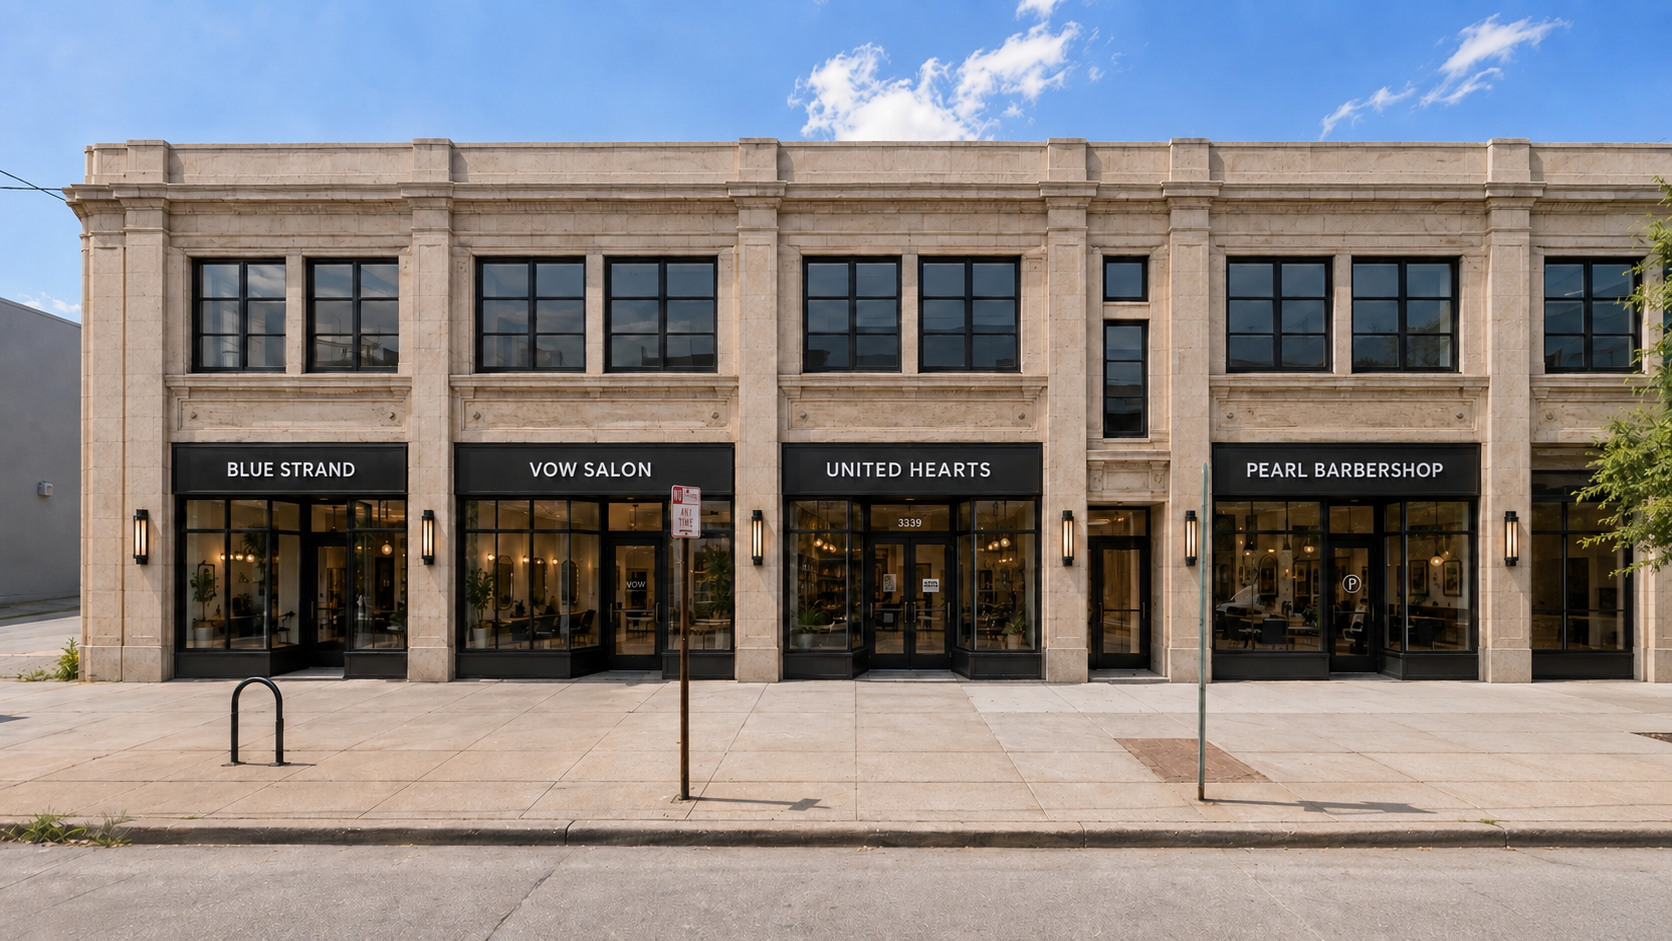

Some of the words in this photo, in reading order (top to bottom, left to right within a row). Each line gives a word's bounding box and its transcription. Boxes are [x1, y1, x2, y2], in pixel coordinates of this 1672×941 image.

[227, 461, 274, 477] BLUE
[280, 461, 356, 477] STRAND
[529, 461, 578, 477] VOW
[583, 461, 652, 477] SALON
[826, 461, 902, 477] UNITED
[910, 461, 991, 477] HEARTS
[1246, 461, 1308, 477] PEARL
[1314, 461, 1444, 477] BARBERSHOP
[898, 518, 922, 528] 3339
[626, 580, 646, 589] VOW
[1348, 577, 1357, 591] P
